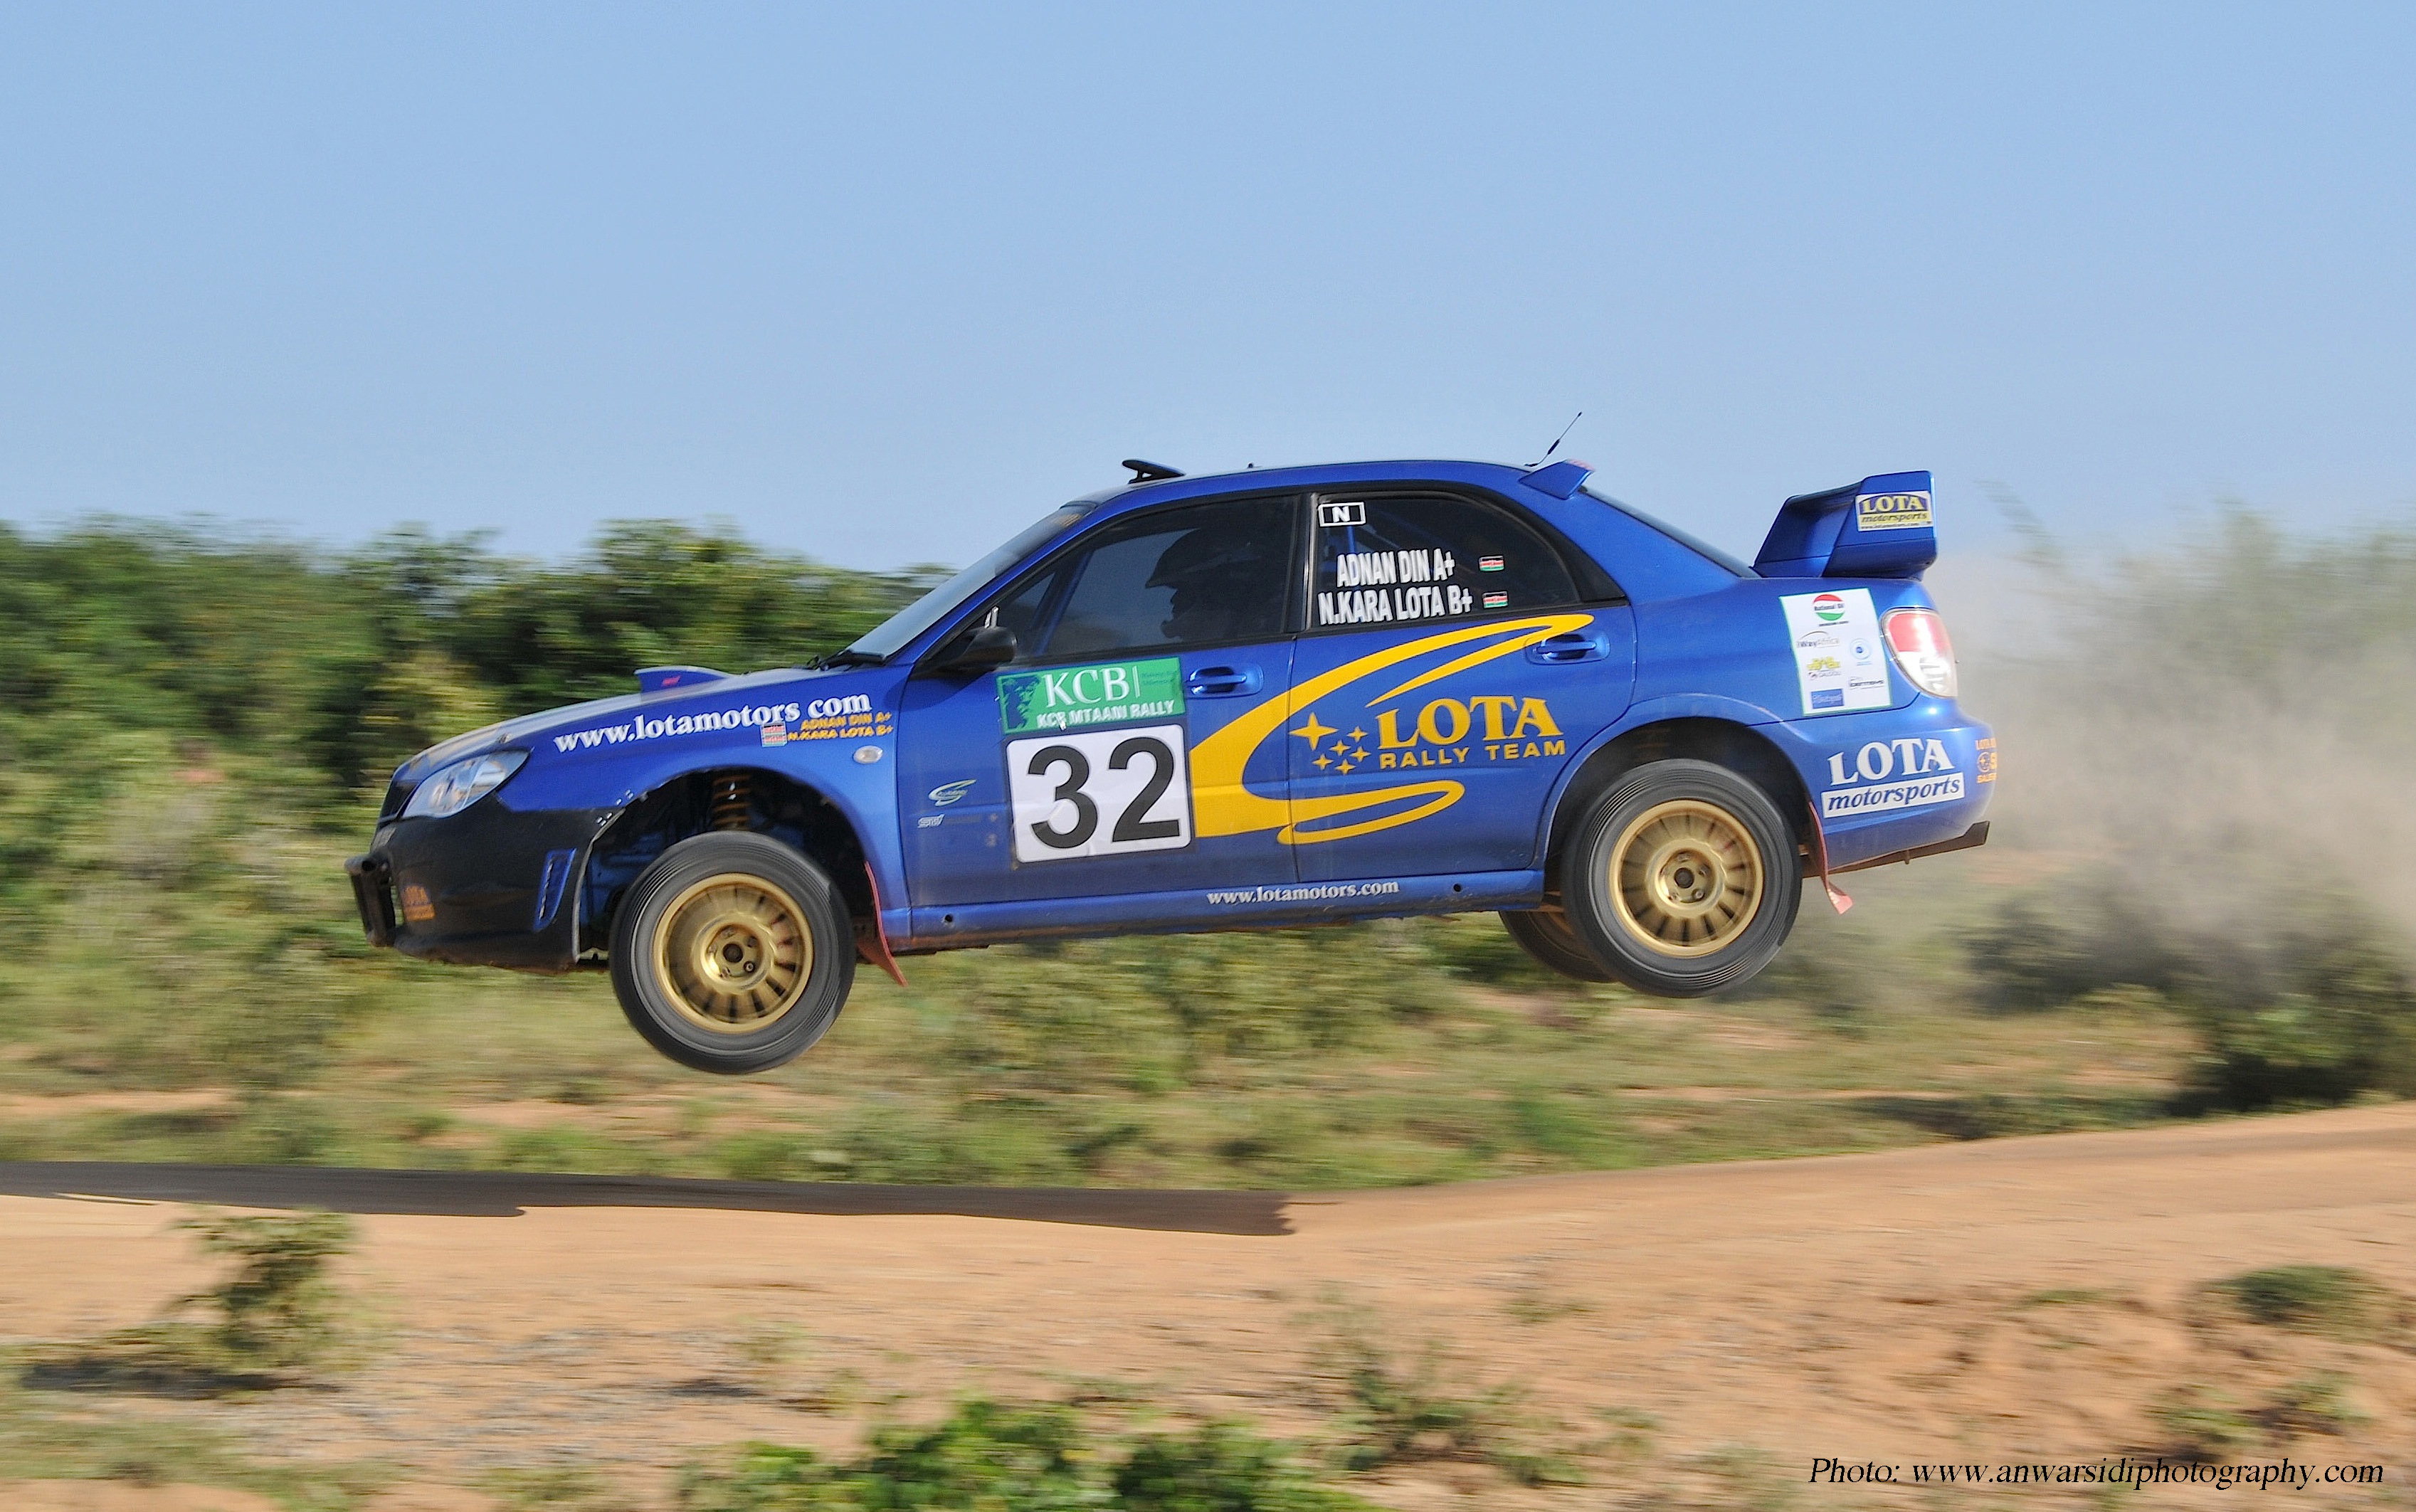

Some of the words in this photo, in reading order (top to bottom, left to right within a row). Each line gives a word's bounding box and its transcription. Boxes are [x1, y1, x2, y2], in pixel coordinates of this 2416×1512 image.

[1331, 506, 1351, 523] N
[1862, 496, 1924, 514] LOTA
[1862, 513, 1927, 523] motorsports
[1336, 550, 1397, 588] ADNAN
[1398, 549, 1431, 584] DIN
[1433, 548, 1455, 581] A+
[1317, 589, 1393, 625] N.KARA
[1394, 586, 1445, 621] LOTA
[1447, 585, 1473, 615] B+
[1043, 666, 1130, 708] KCB
[800, 715, 848, 731] ADNAN
[848, 713, 873, 725] DIN
[1069, 704, 1127, 725] MTAANI
[1130, 699, 1175, 718] RALLY
[1376, 695, 1564, 750] LOTA
[839, 726, 875, 739] LOTA
[1379, 747, 1470, 770] RALLY
[1486, 739, 1566, 761] TEAM
[1827, 739, 1956, 786] LOTA
[1028, 737, 1180, 849] 32
[1827, 777, 1961, 811] motorsports
[1207, 881, 1400, 904] www.lotamotors.com
